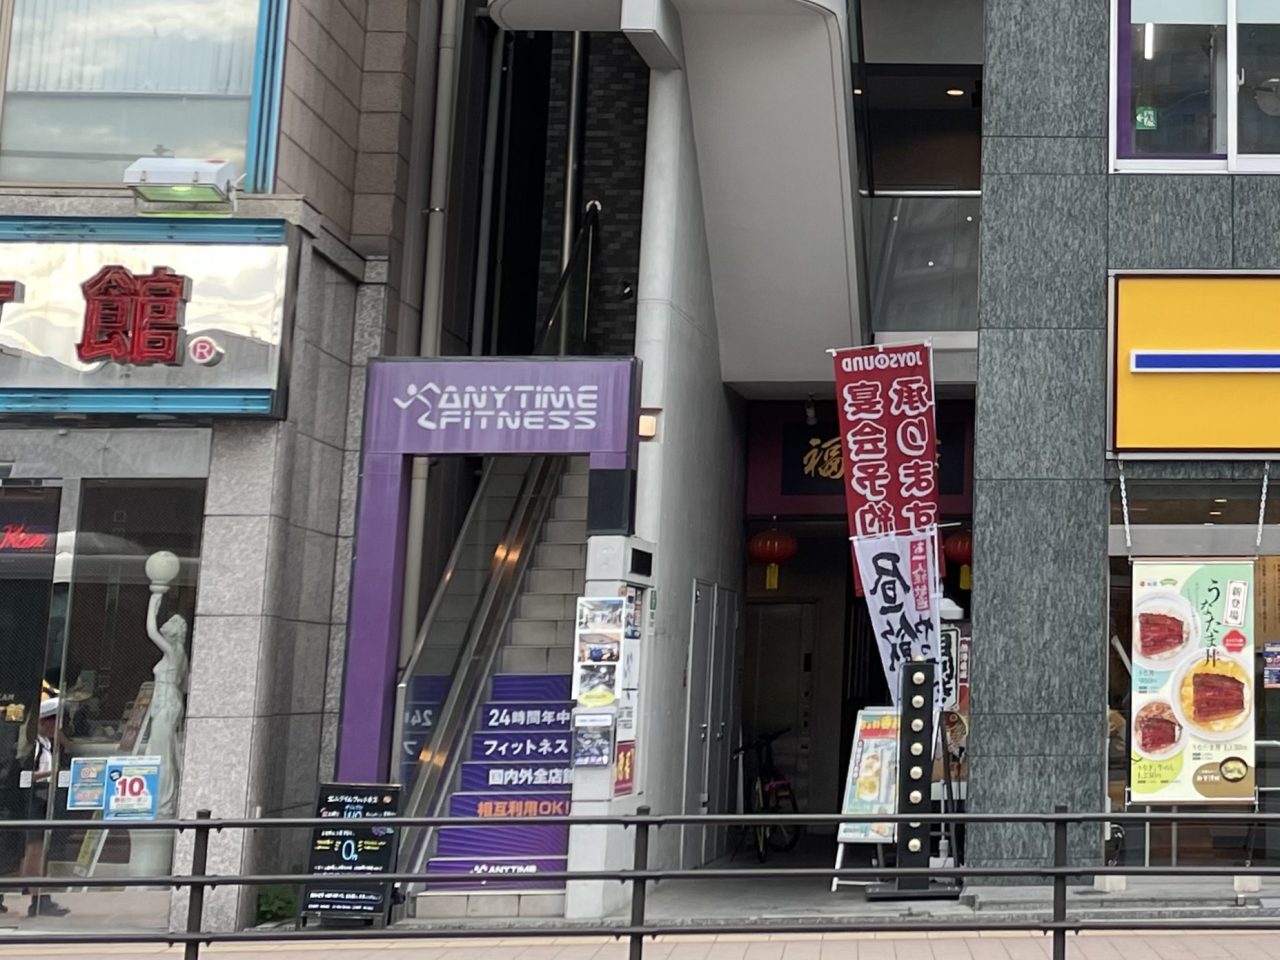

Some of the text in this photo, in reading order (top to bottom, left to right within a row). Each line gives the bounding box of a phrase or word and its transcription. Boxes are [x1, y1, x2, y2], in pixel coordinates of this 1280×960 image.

[76, 265, 193, 367] 館
[437, 385, 599, 409] ANYTIME
[439, 410, 597, 430] FITNESS
[488, 708, 570, 726] 24時間年中
[483, 740, 569, 755] フィットネス
[117, 776, 145, 797] 10
